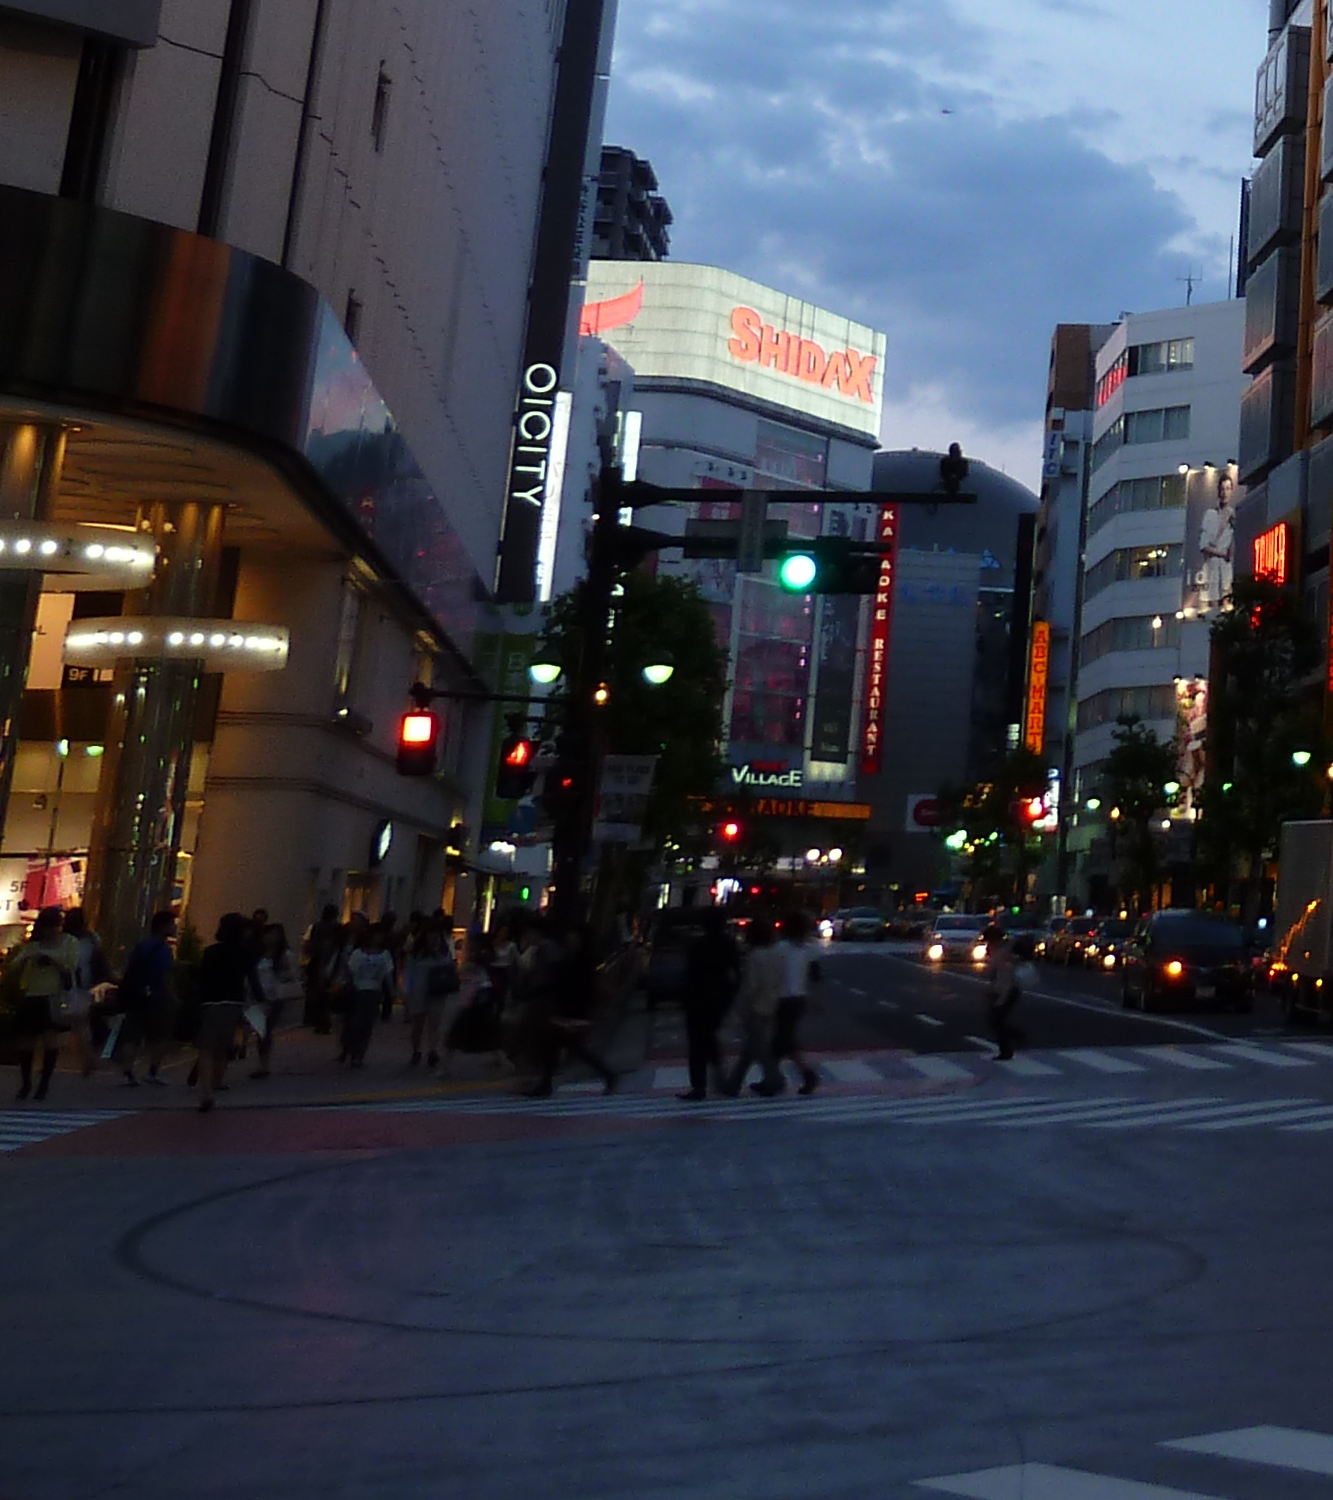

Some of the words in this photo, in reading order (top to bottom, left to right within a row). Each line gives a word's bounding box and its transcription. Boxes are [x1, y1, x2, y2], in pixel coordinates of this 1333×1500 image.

[729, 306, 877, 404] SHIDAX
[874, 509, 895, 620] KAAOKE
[864, 637, 885, 756] RESTAURANT
[731, 764, 802, 787] VILLAGE
